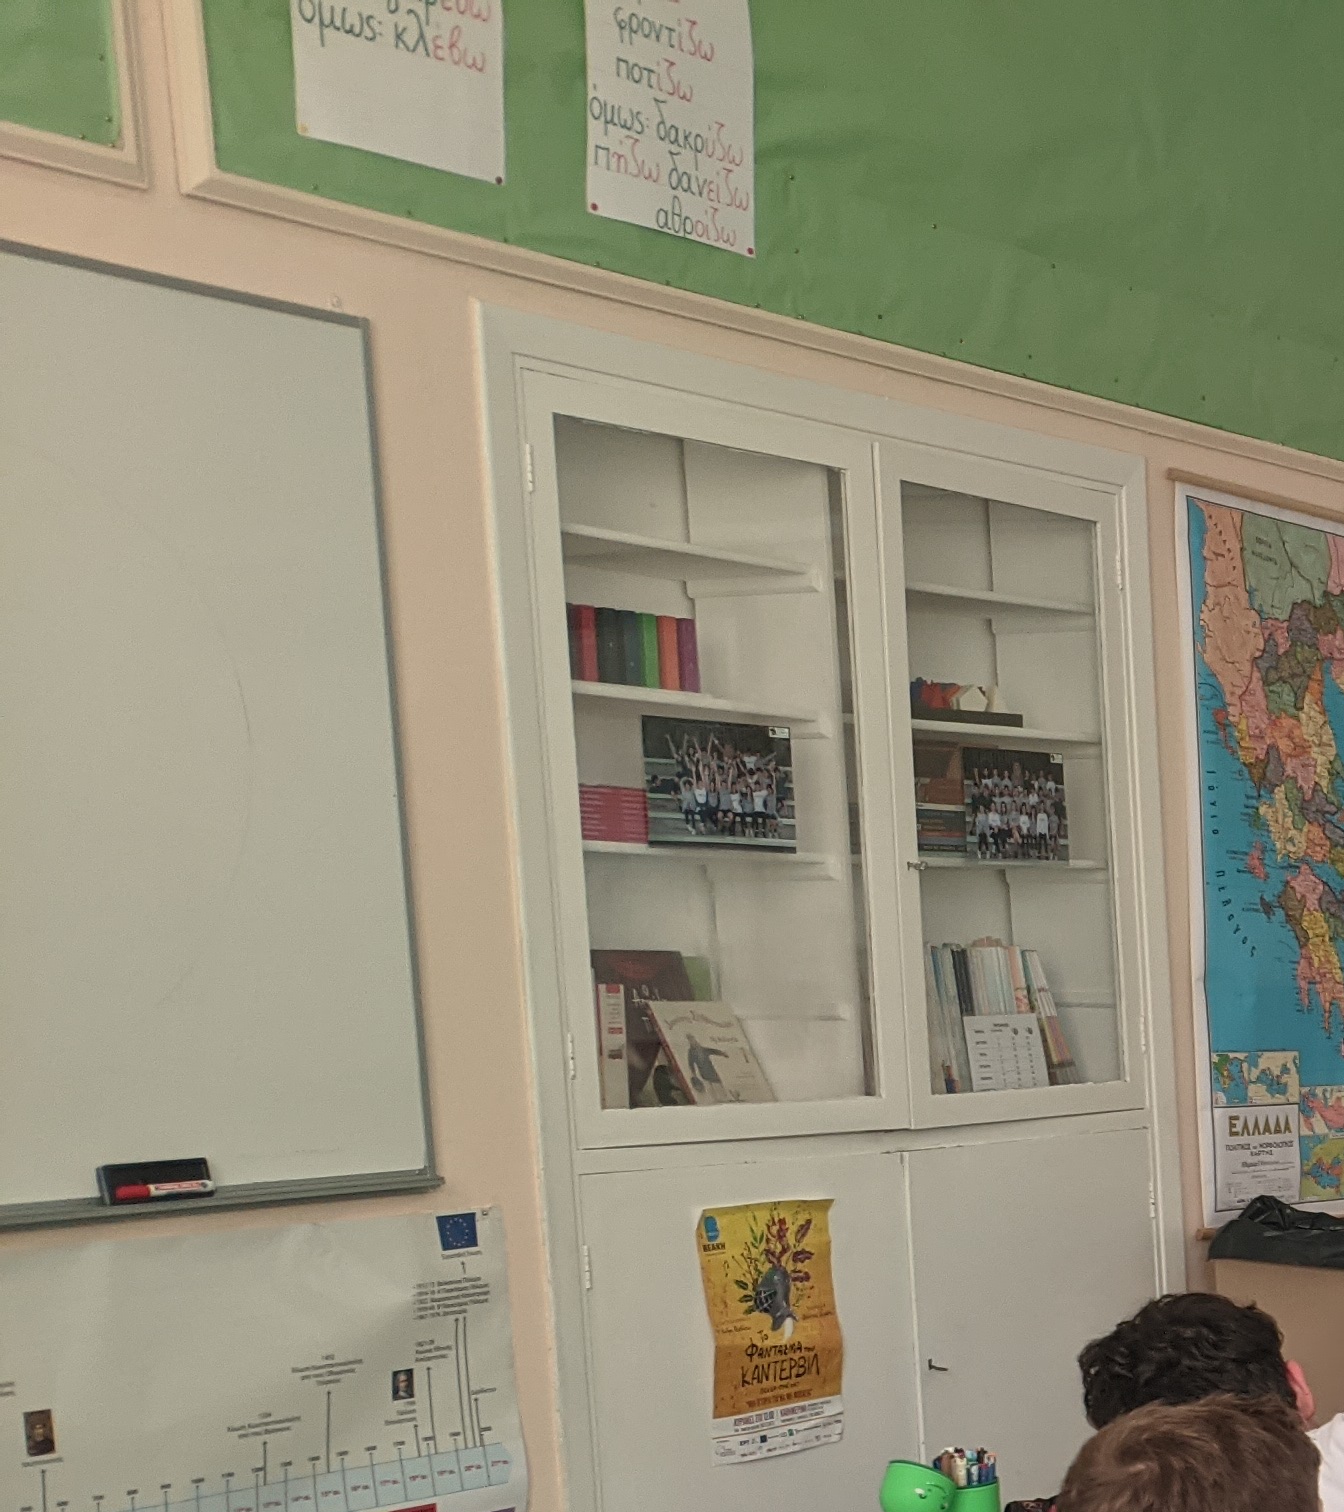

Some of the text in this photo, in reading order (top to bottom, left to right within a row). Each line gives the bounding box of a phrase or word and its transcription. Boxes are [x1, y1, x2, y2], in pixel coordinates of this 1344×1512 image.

[613, 6, 715, 62] φροντίζω
[616, 56, 694, 102] ποτίζω
[653, 97, 744, 171] δακρύζω
[668, 150, 749, 211] δανείζω
[656, 195, 737, 247] αθροίζω
[1228, 1113, 1292, 1137] ΕΛΛΑΔΑ
[740, 1353, 820, 1388] ΚΑΝΤΕΡΒΙΛ
